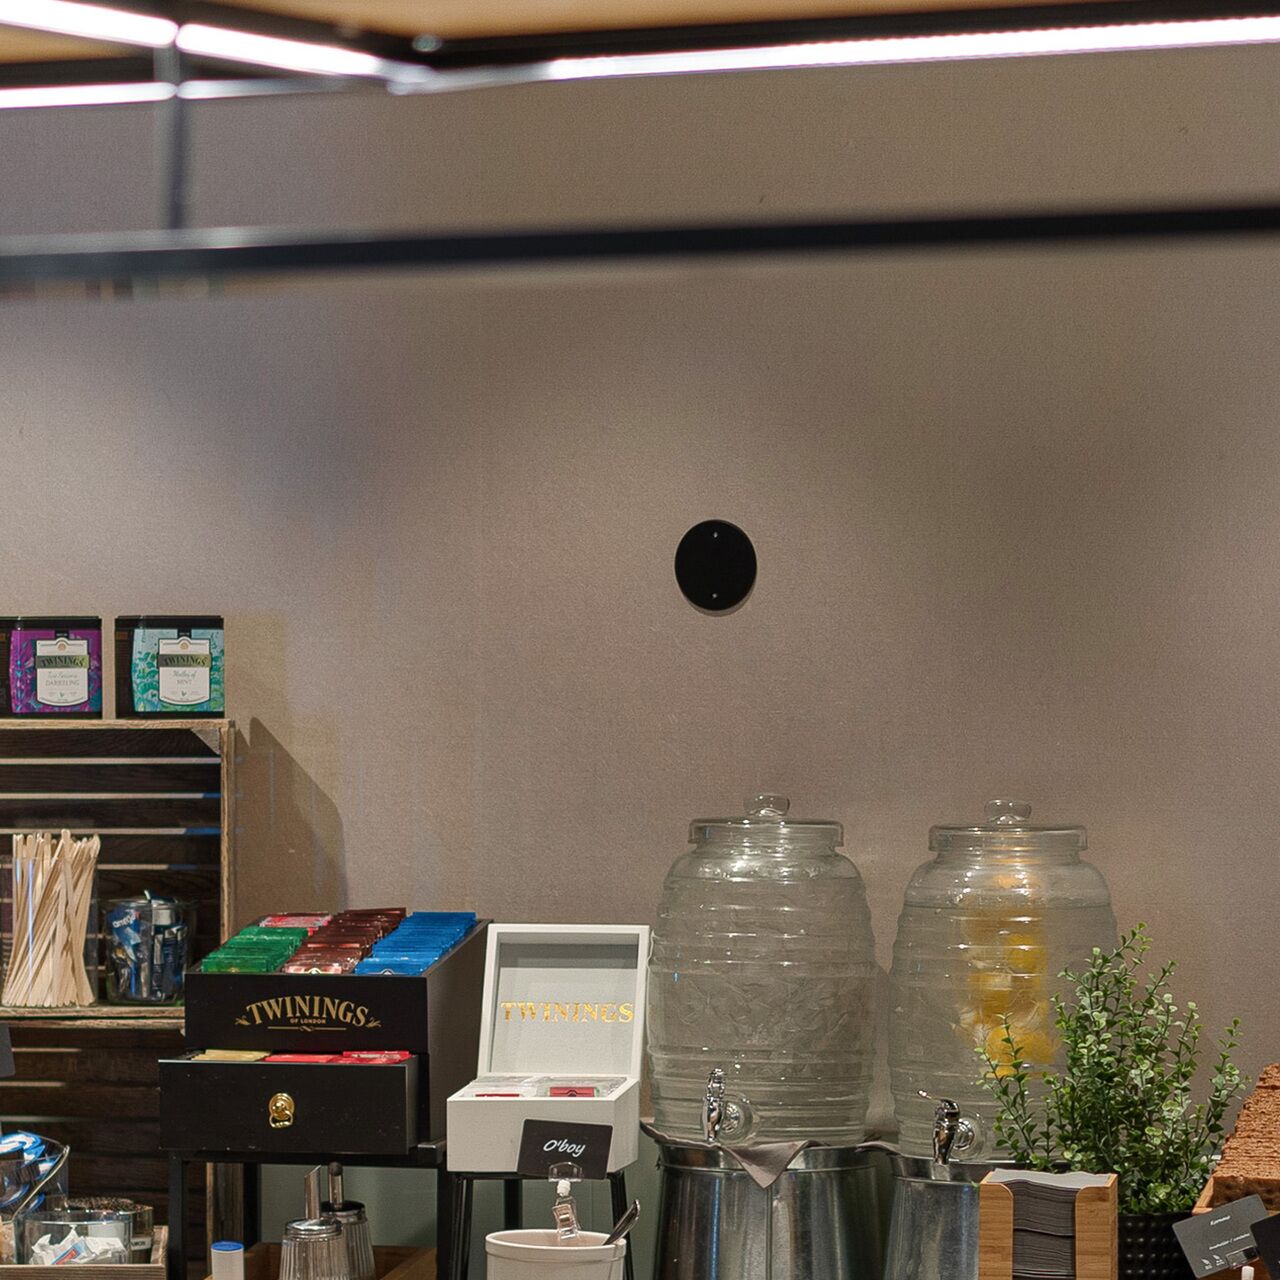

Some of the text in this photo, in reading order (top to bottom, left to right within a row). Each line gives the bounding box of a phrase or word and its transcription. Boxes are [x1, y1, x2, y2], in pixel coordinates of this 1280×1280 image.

[41, 656, 86, 668] TWININGS
[164, 655, 209, 667] TWININGS
[246, 995, 369, 1027] TWININGS
[501, 1001, 635, 1024] TWININGS
[543, 1138, 586, 1158] O'boy
